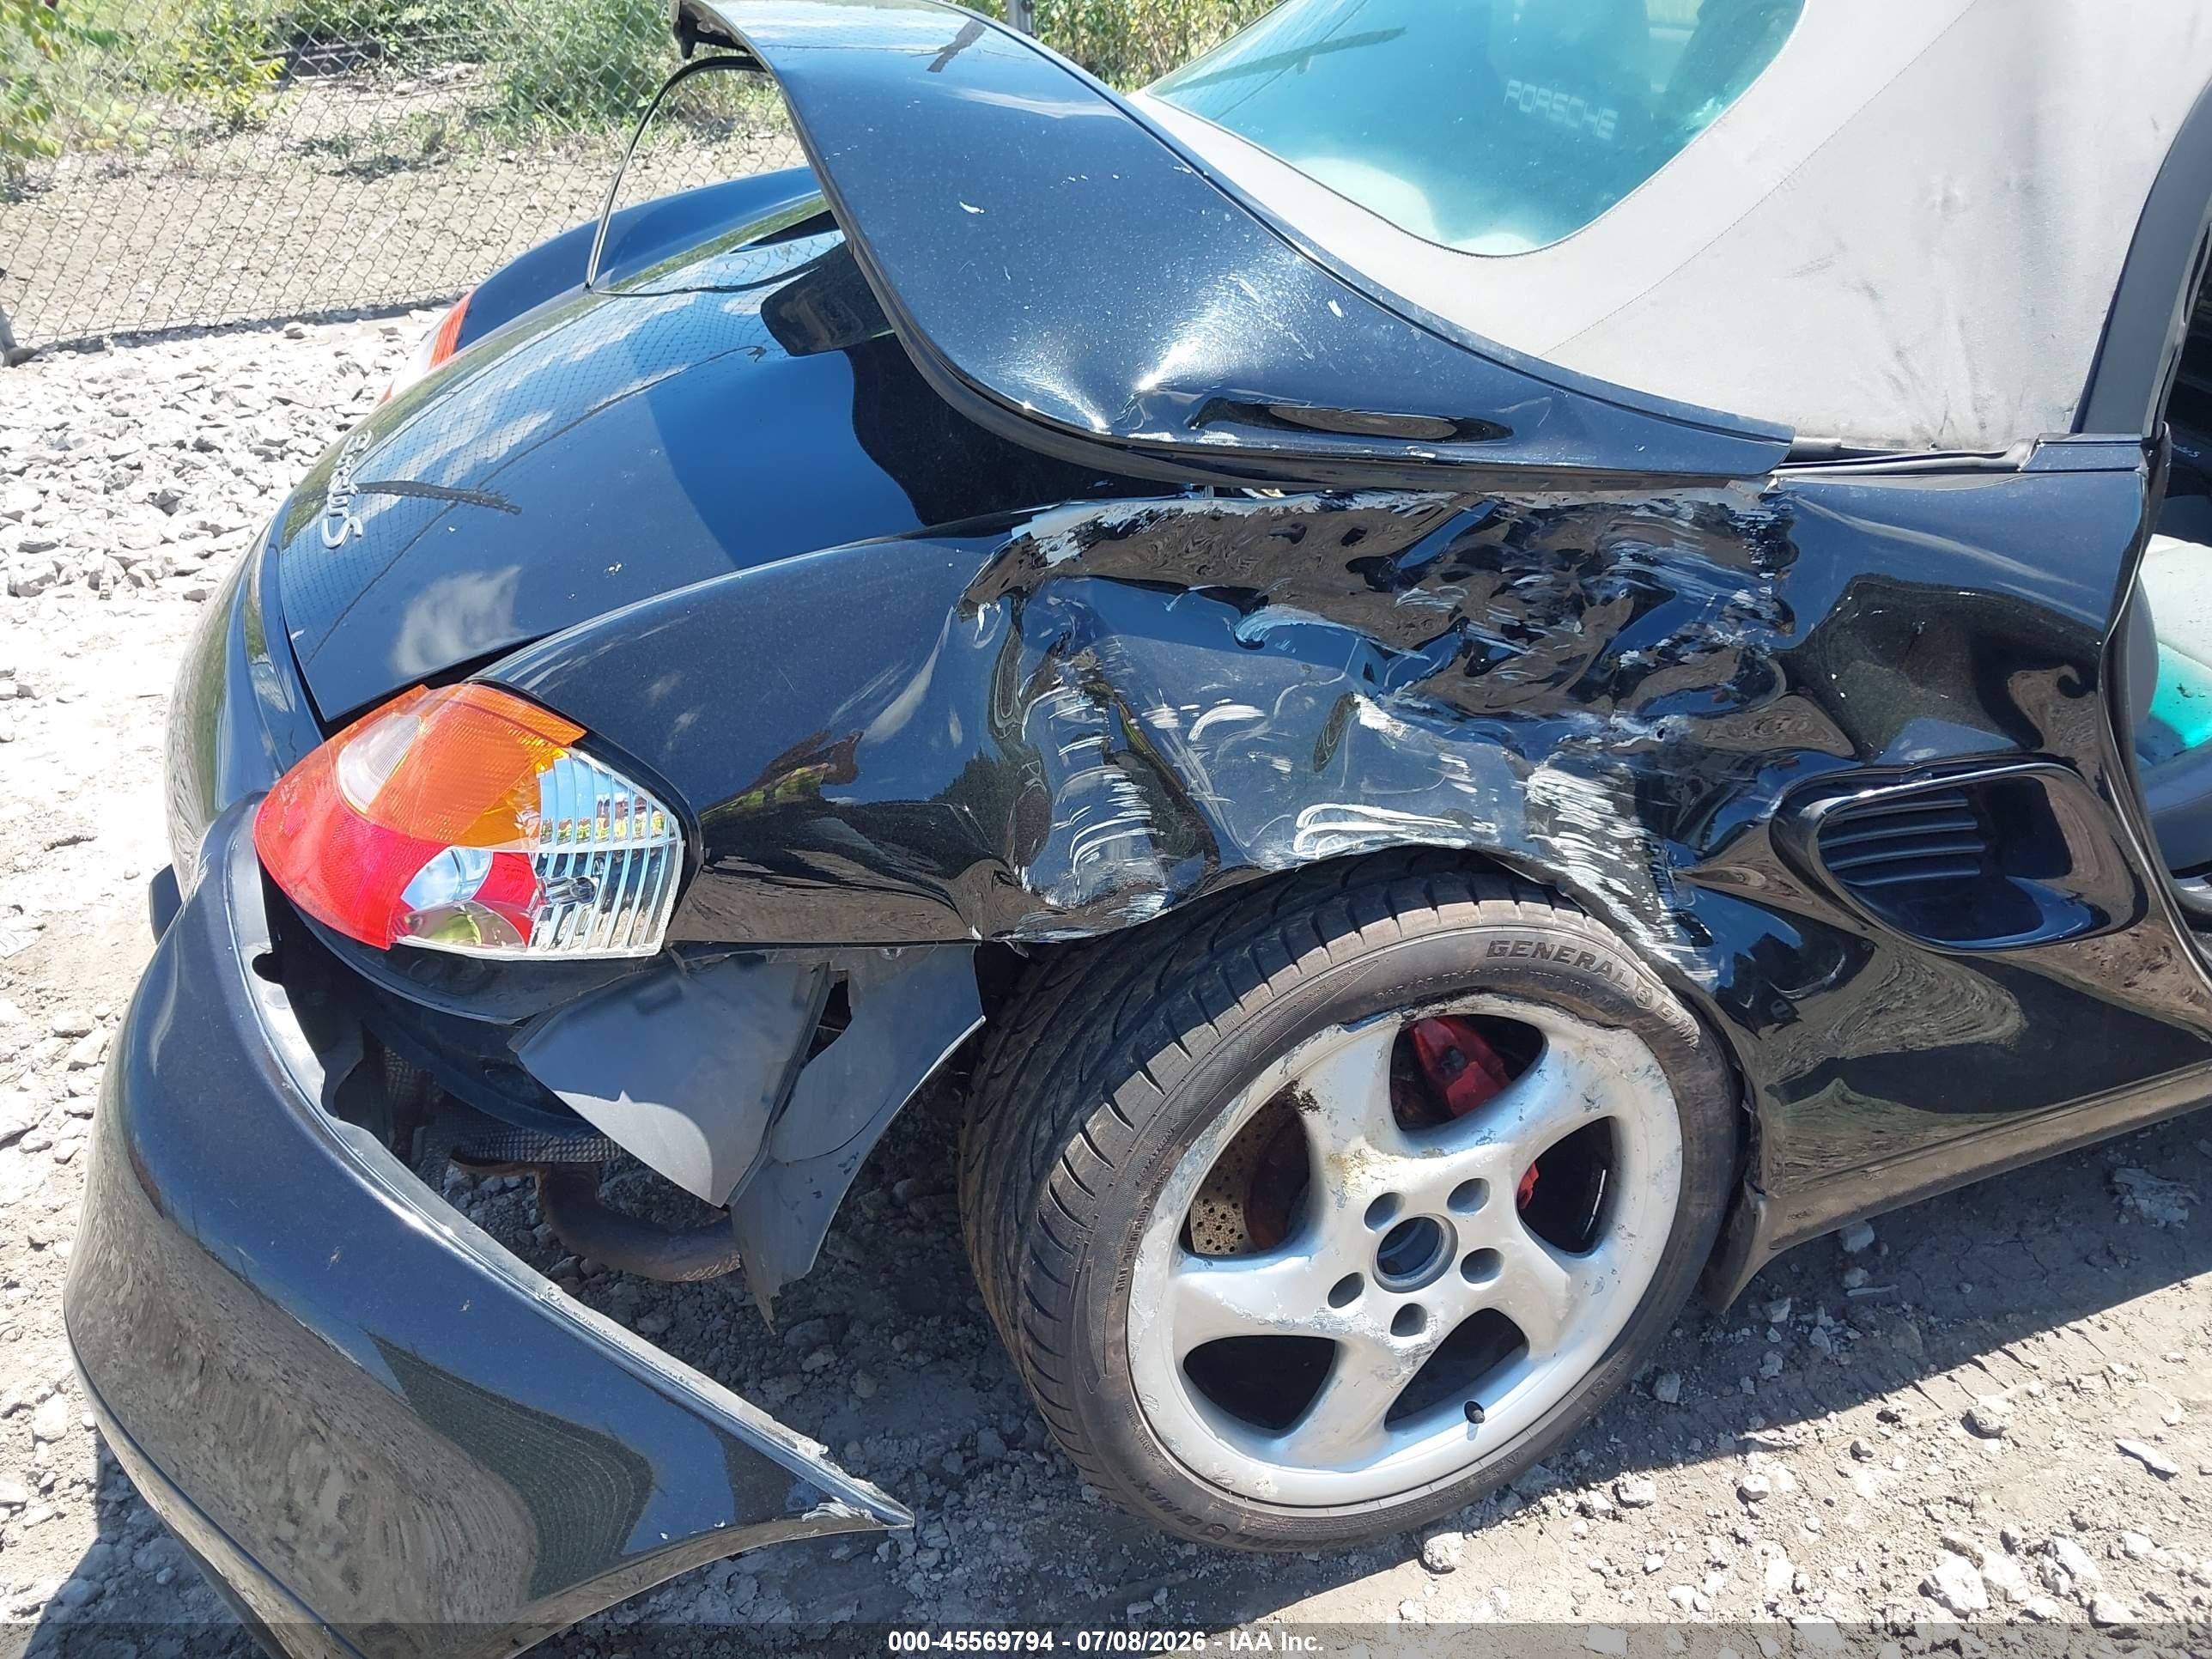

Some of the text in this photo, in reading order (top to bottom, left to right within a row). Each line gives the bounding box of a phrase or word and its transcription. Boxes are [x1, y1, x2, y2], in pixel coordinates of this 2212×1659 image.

[1504, 79, 1619, 141] PORSCHE
[321, 516, 363, 550] S
[1486, 939, 1630, 992] GENERAL
